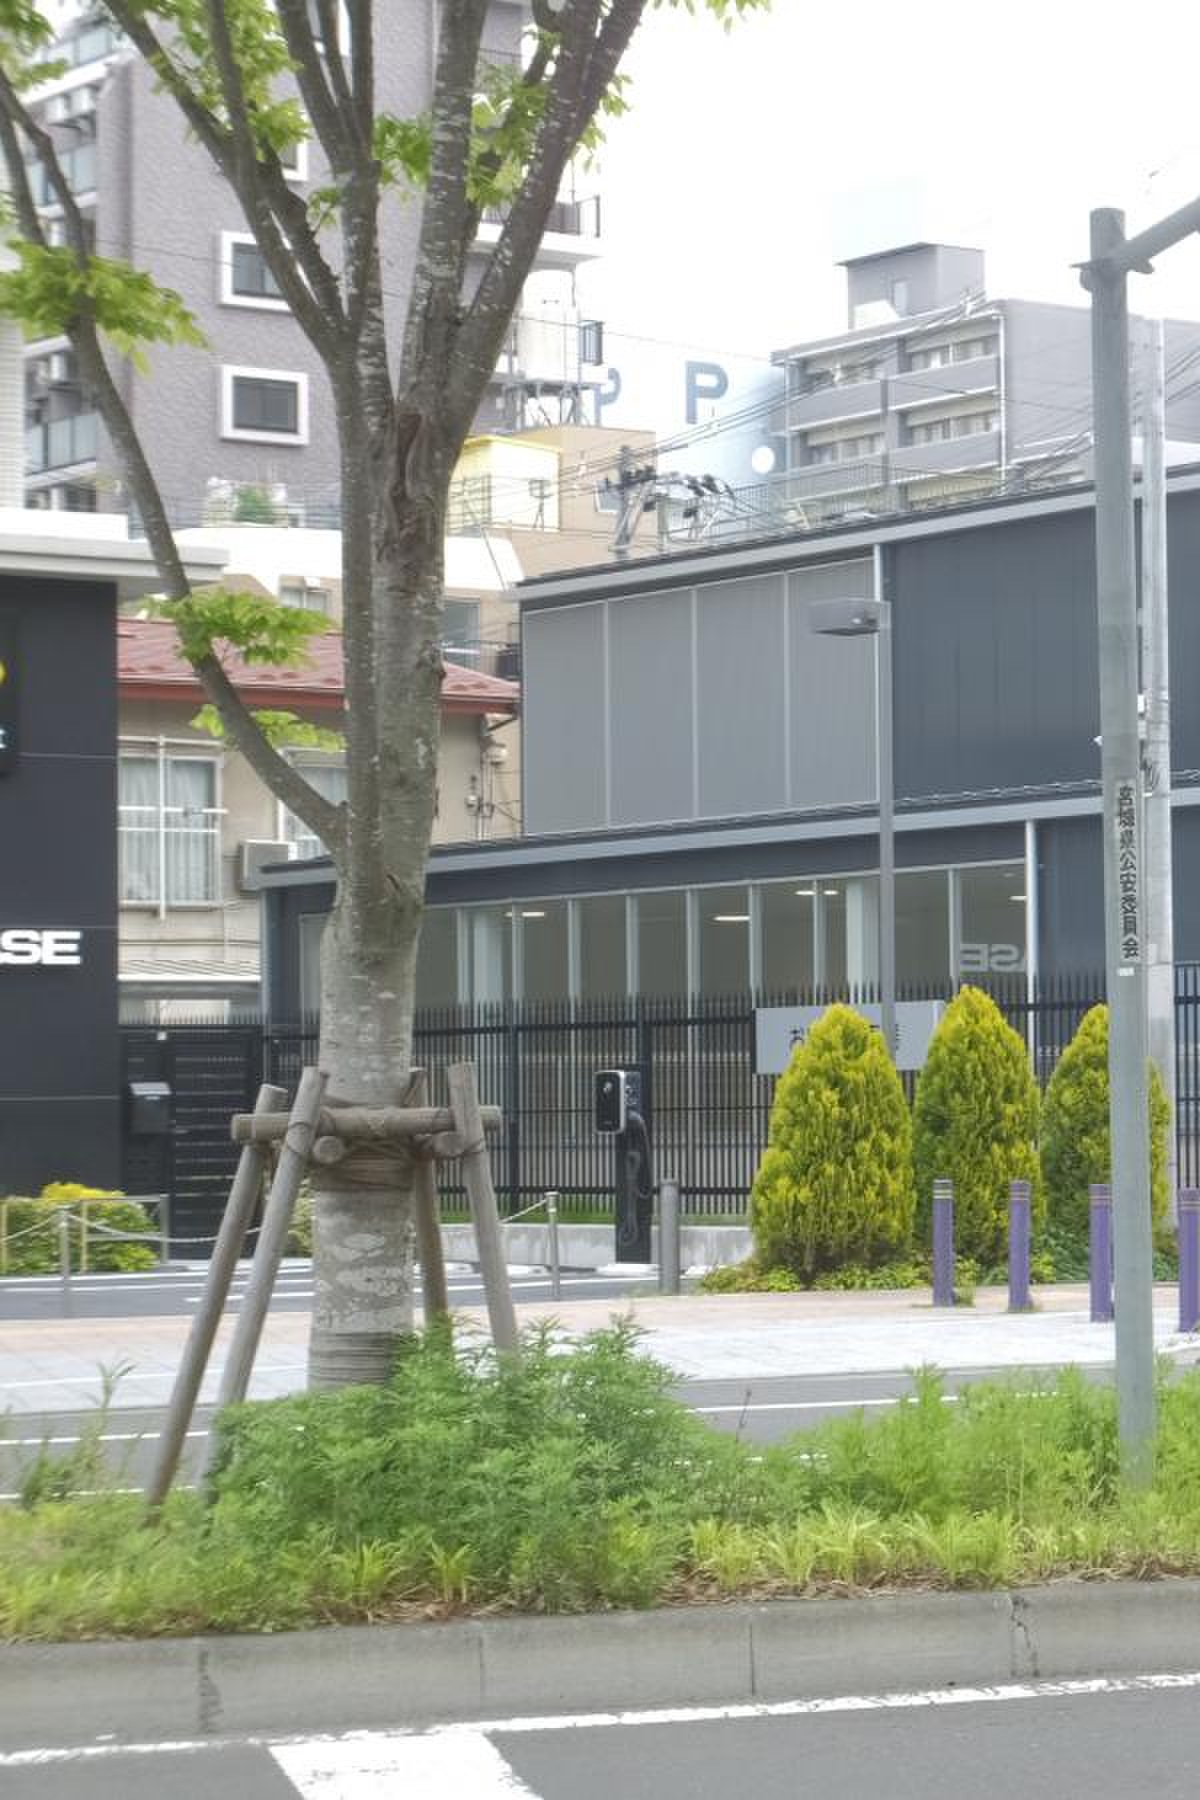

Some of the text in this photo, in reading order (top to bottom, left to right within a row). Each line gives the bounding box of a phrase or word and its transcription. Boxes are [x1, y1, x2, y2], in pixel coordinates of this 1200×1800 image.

[684, 361, 729, 425] P
[1119, 785, 1139, 960] 宮城県公安委員会
[0, 930, 82, 966] SE
